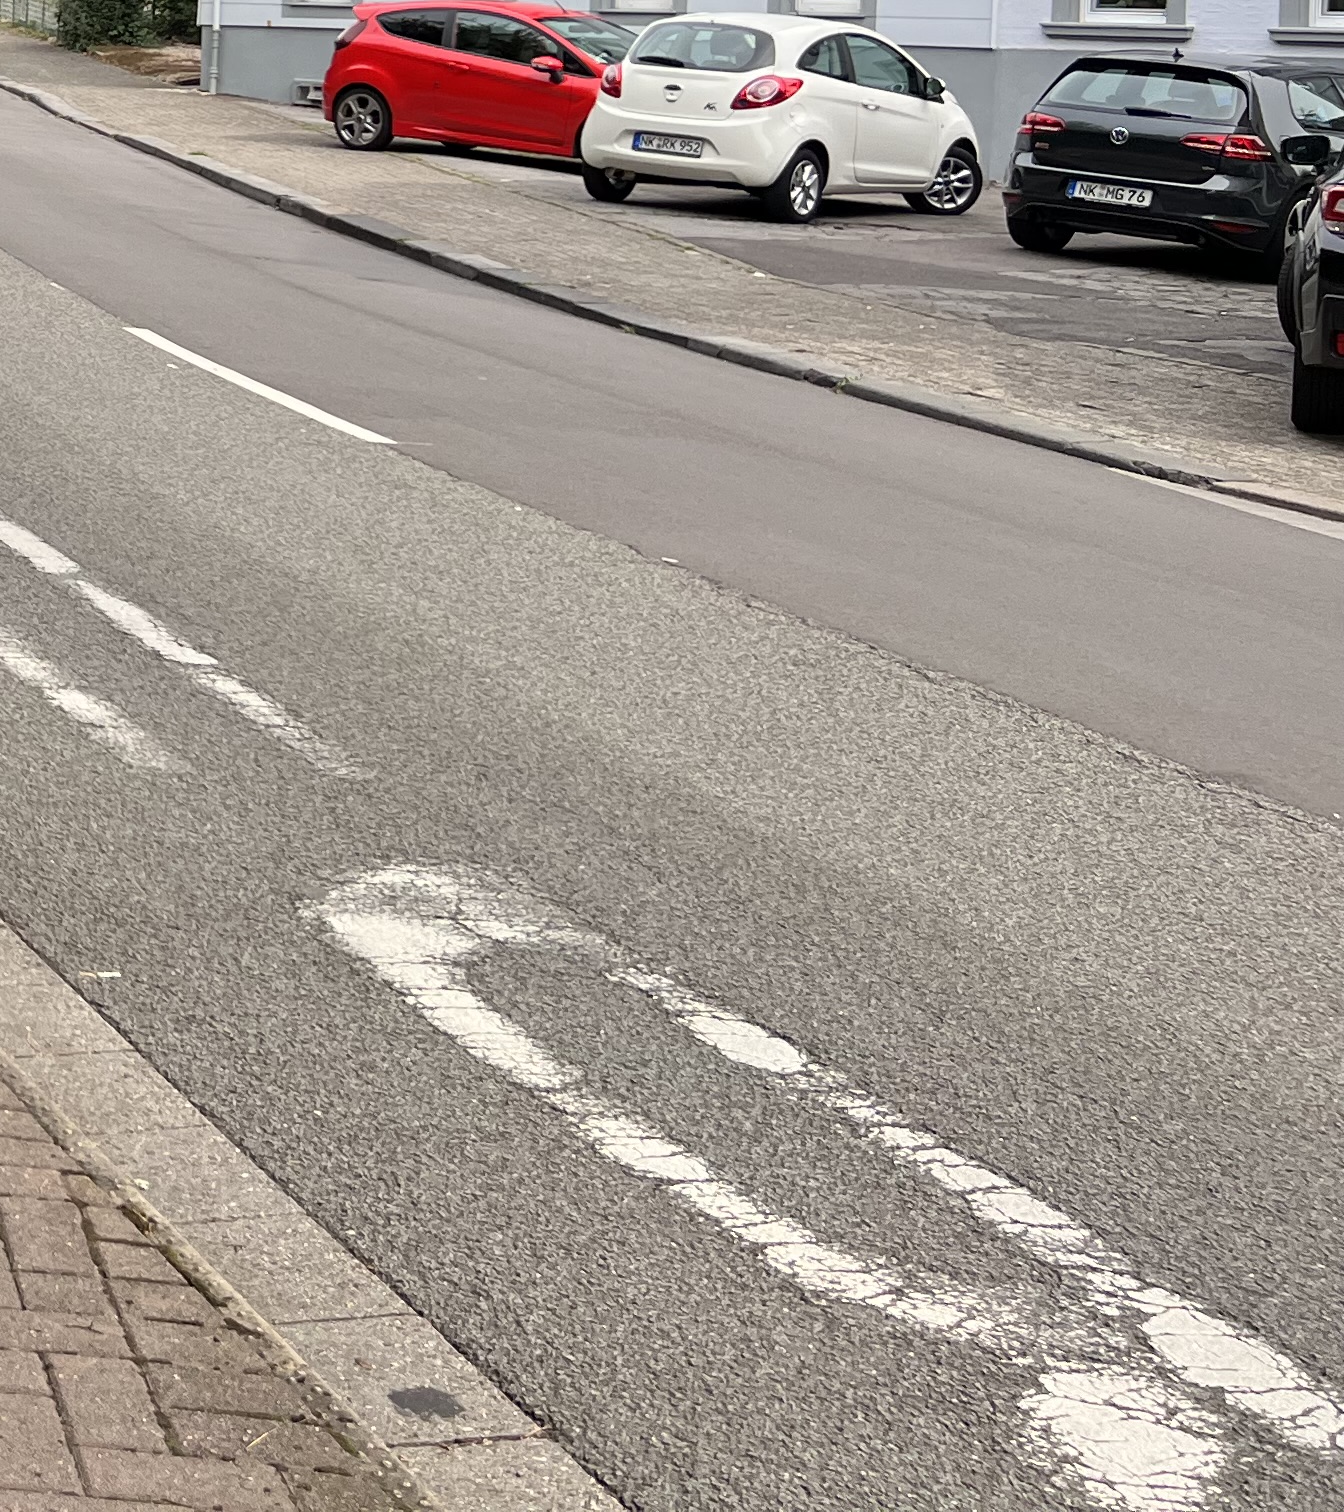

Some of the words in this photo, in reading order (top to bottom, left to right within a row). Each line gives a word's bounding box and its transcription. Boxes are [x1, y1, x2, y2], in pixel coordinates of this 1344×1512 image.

[641, 136, 655, 148] NK
[662, 139, 676, 150] RK
[679, 140, 700, 154] 952
[1078, 183, 1096, 197] NK
[1105, 186, 1124, 200] MG
[1127, 190, 1146, 203] 76
